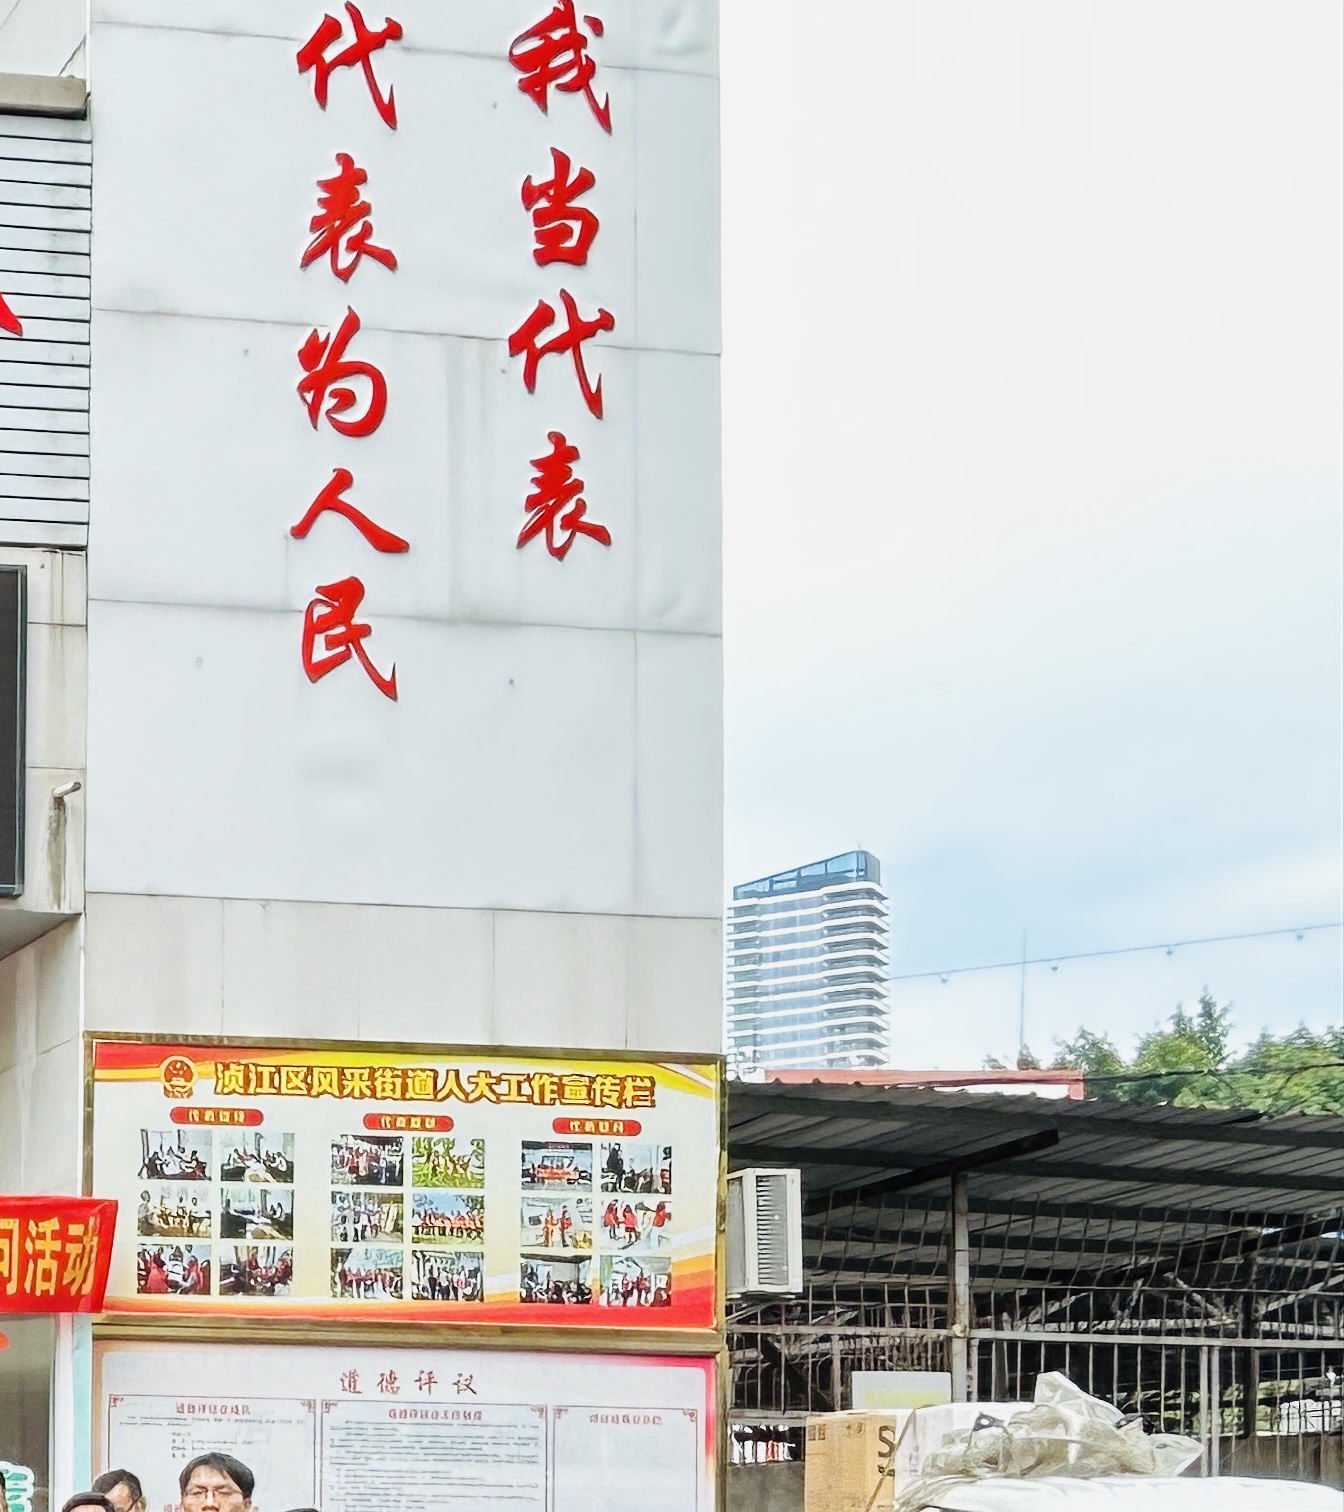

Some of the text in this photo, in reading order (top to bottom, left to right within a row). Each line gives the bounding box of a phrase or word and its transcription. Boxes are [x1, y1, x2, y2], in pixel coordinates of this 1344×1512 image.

[290, 2, 410, 701] 代表为人民
[509, 0, 614, 560] 我当代表
[339, 1369, 478, 1396] 道德评议
